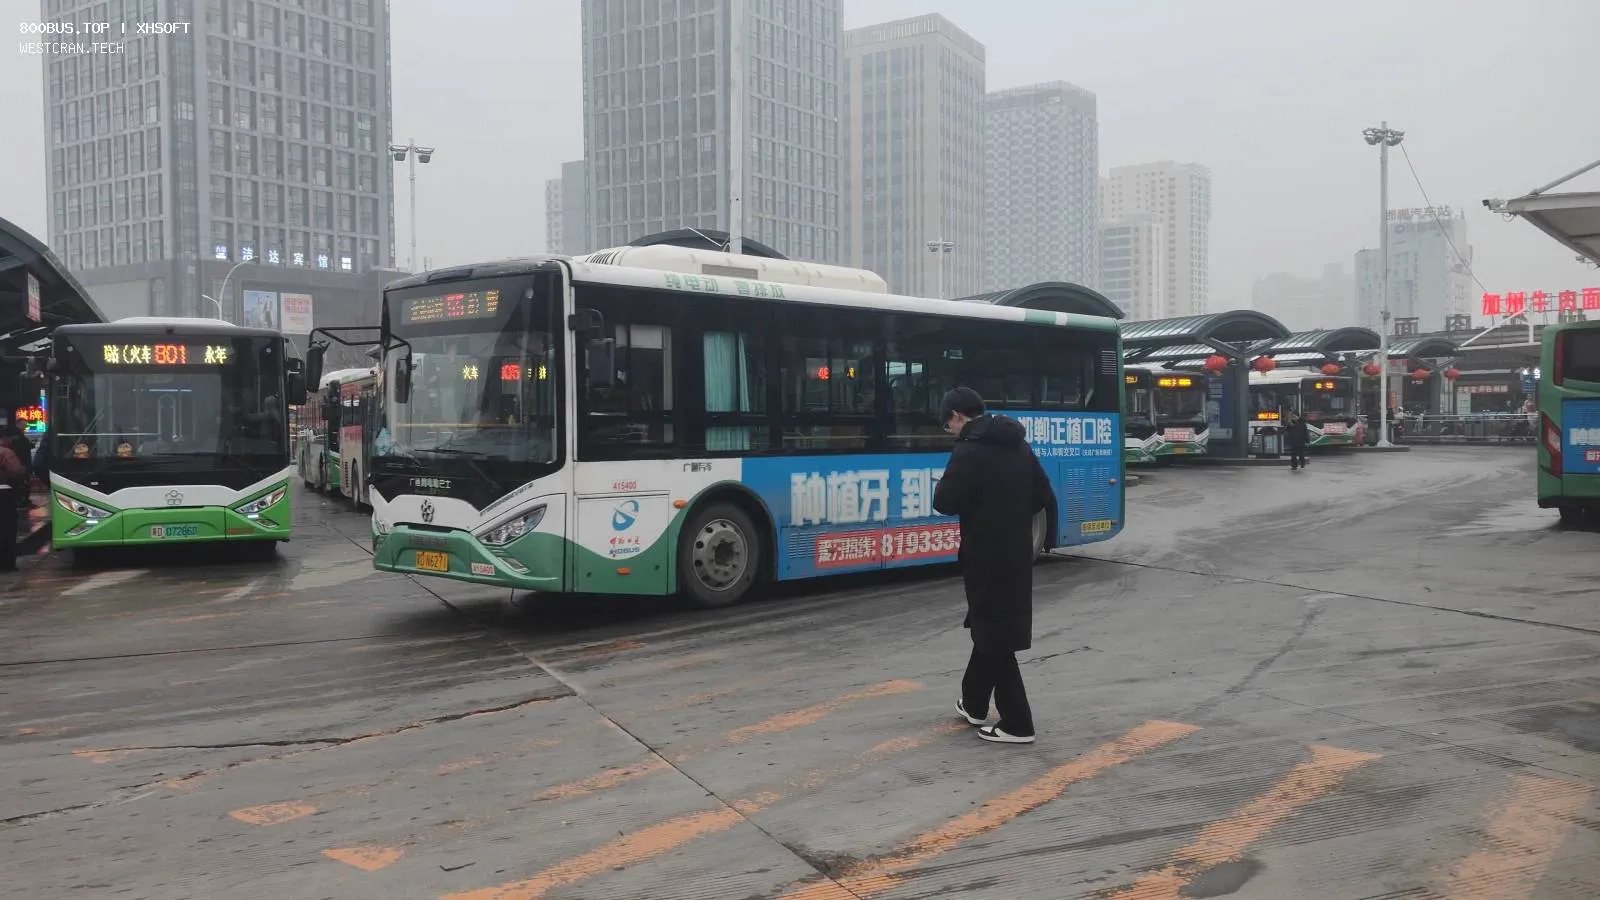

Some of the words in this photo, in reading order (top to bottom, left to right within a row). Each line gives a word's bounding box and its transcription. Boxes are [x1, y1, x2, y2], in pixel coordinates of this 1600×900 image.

[1482, 288, 1600, 316] 加州牛肉面
[153, 344, 187, 365] 801
[204, 345, 227, 364] 永年
[1018, 416, 1112, 444] 邯郸正植口腔
[613, 481, 637, 490] 415400
[790, 470, 889, 526] 种植牙
[900, 467, 946, 518] 到
